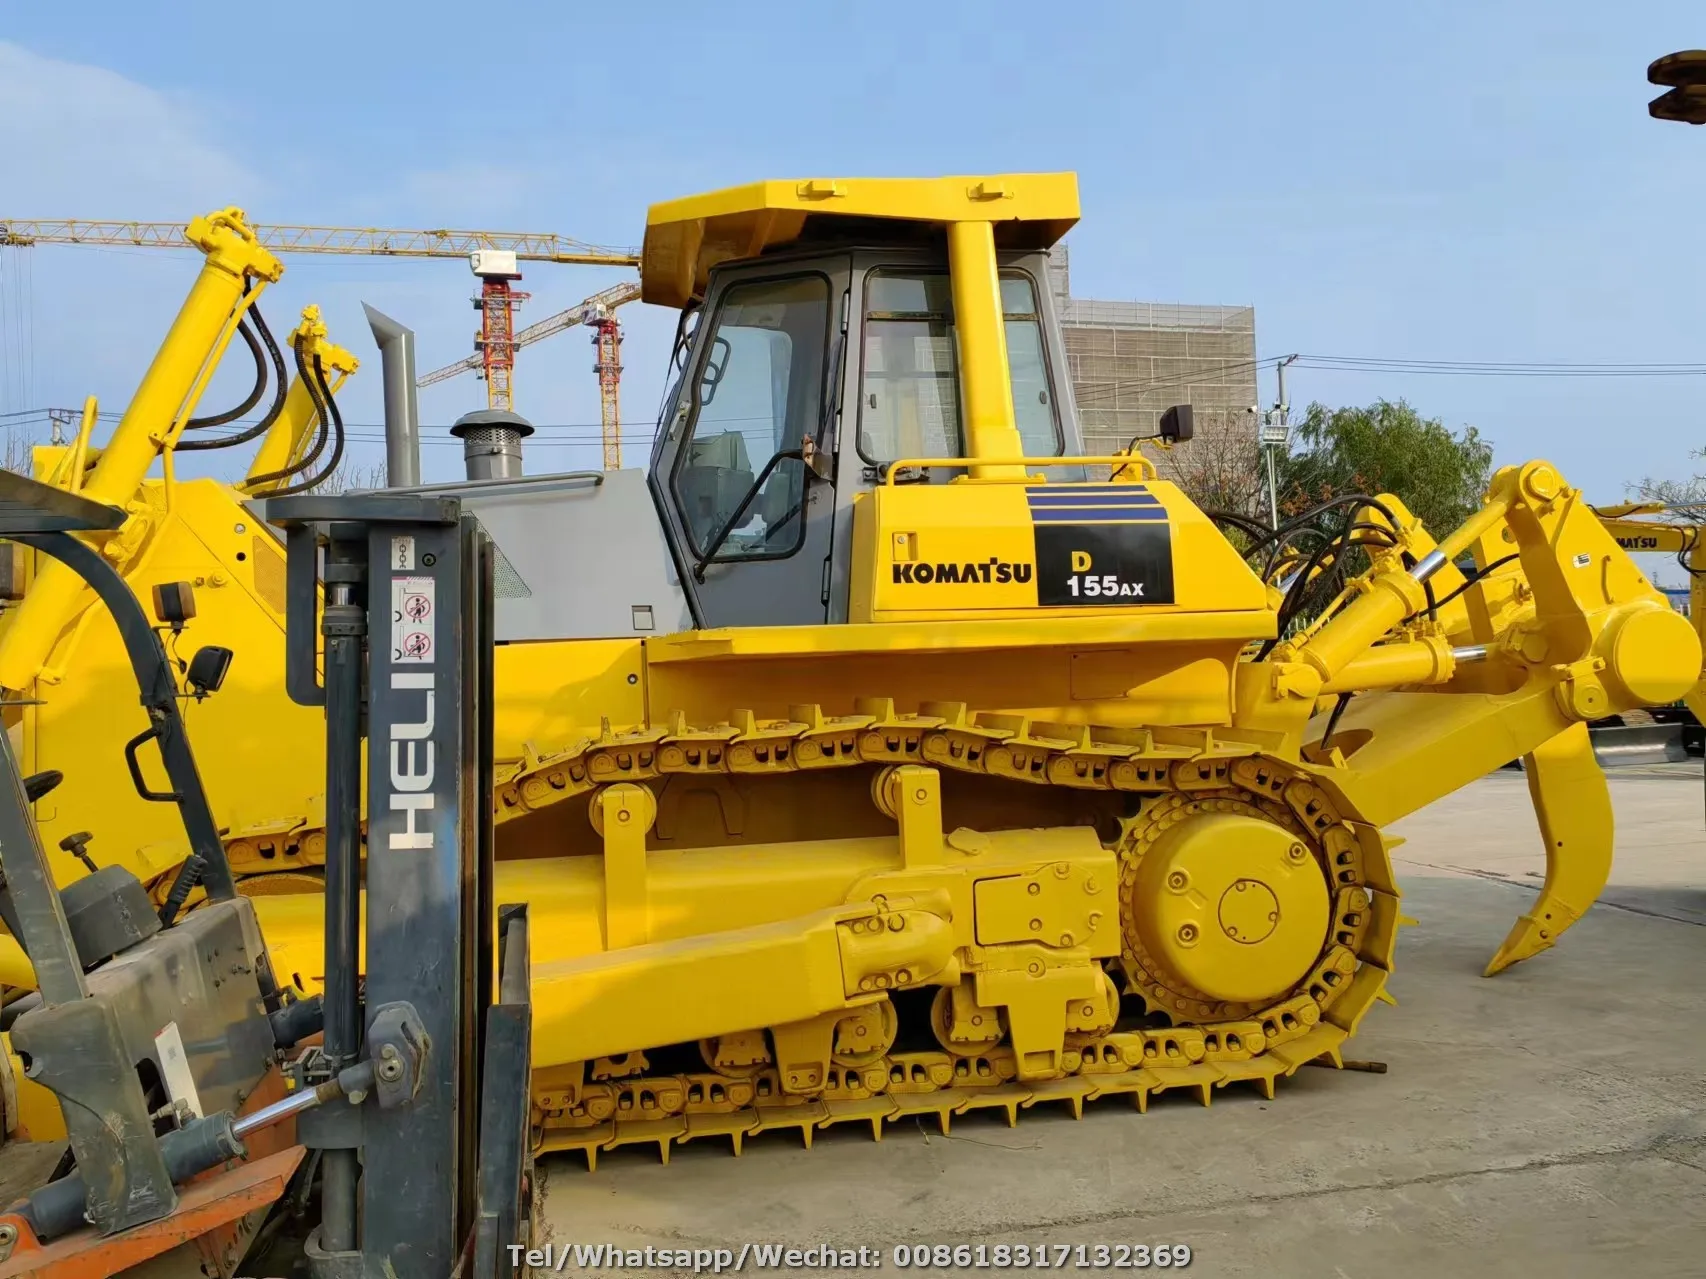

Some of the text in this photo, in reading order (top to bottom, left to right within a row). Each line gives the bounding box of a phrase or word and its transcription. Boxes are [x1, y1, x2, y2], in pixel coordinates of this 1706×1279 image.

[892, 557, 1032, 584] KOMATSU
[1071, 551, 1092, 572] D
[1067, 575, 1144, 597] 155AX
[389, 673, 435, 849] HELI
